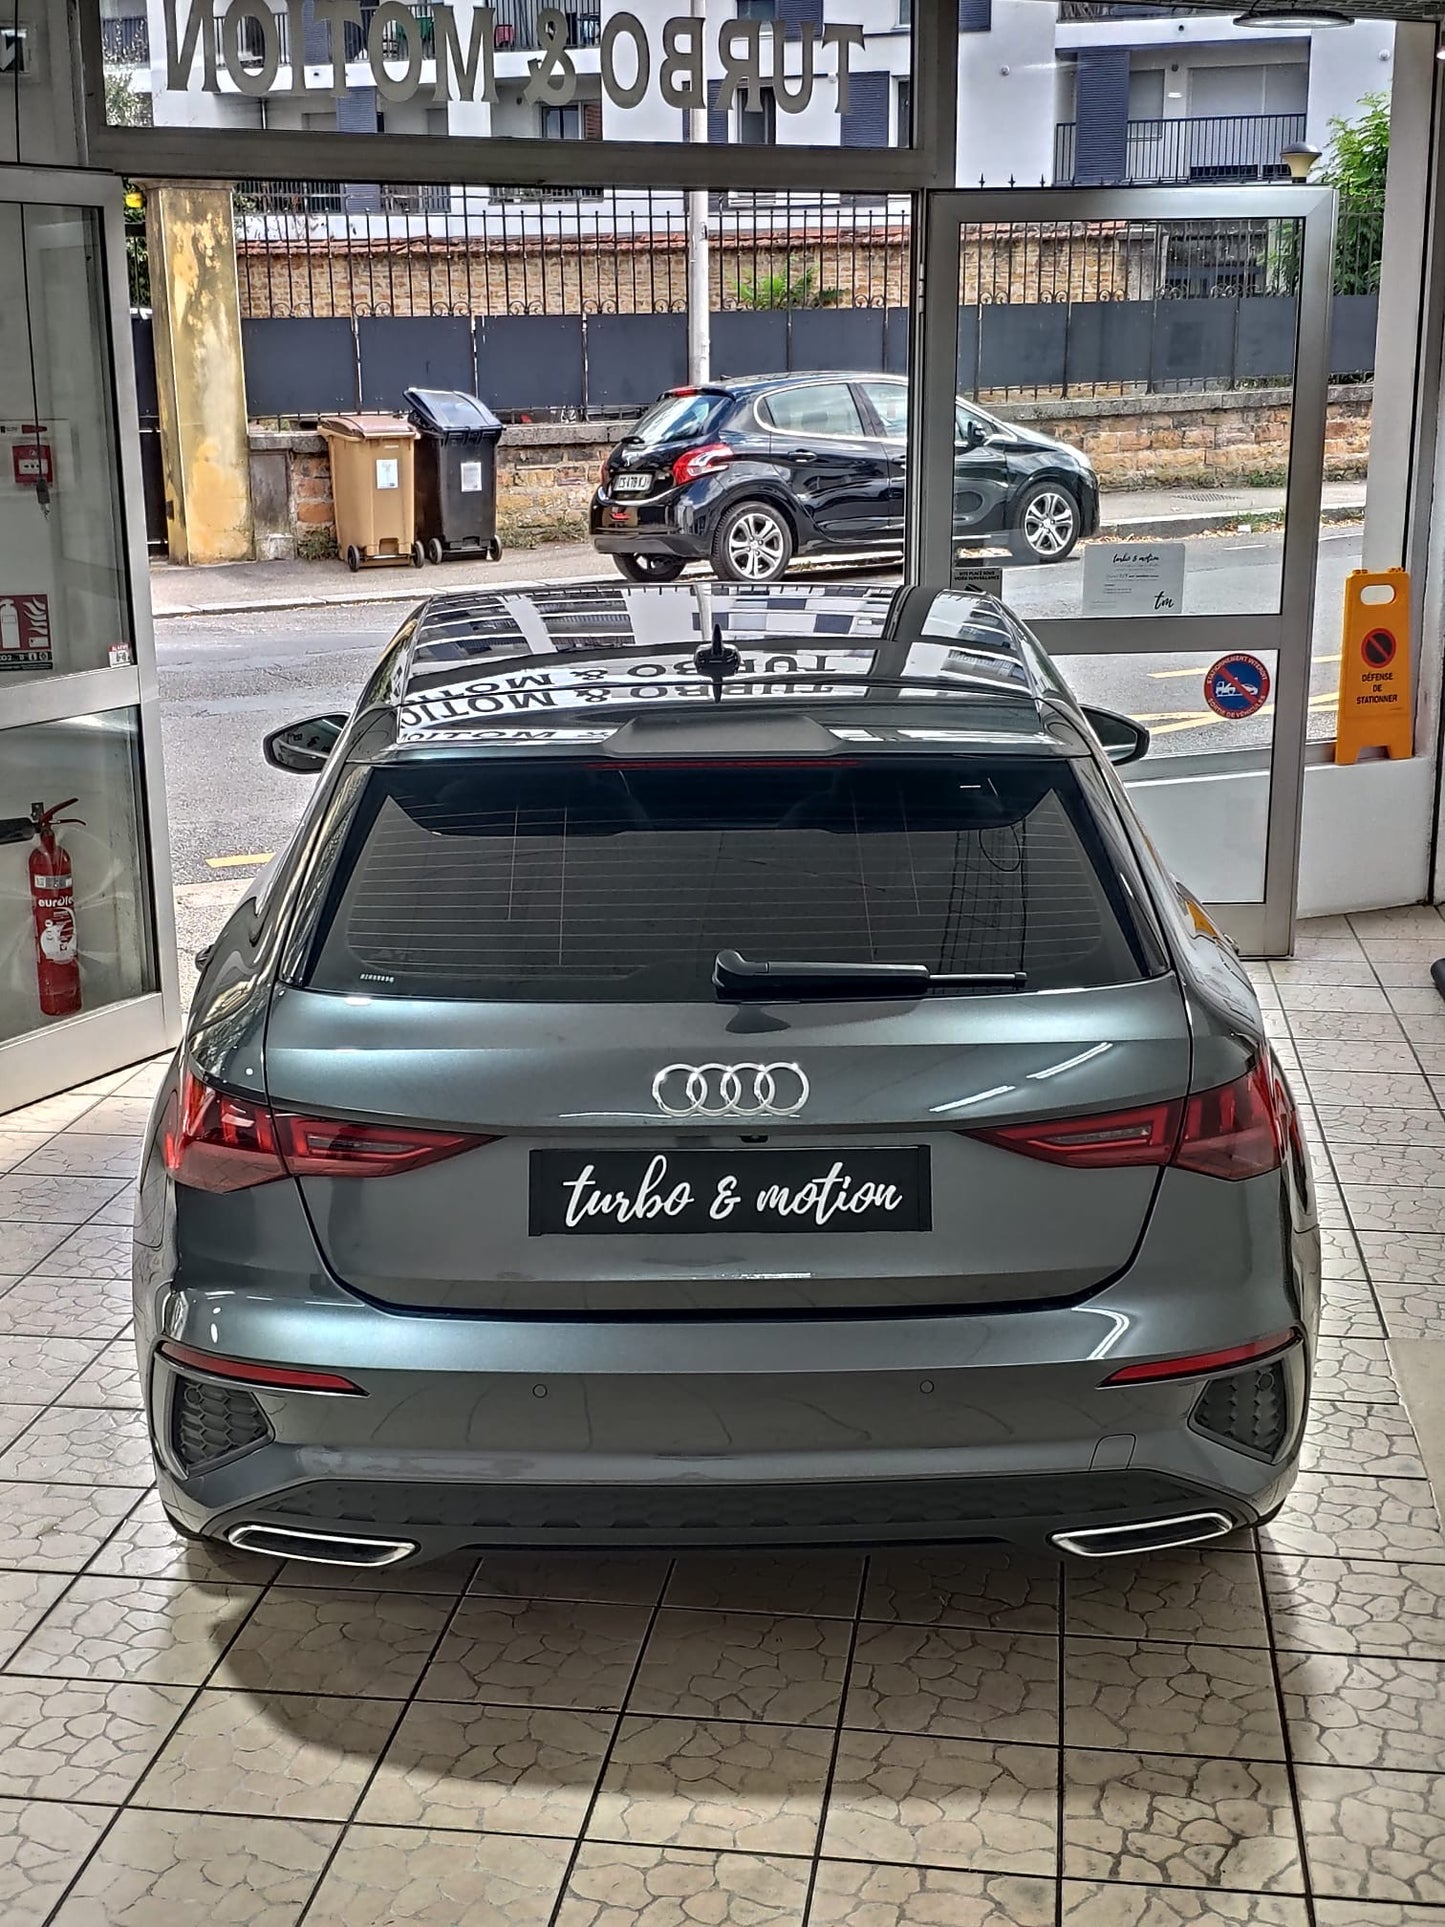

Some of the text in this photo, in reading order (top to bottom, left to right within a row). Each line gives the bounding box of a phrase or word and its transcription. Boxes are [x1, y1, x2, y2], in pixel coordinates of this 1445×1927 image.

[1361, 671, 1394, 682] DÉFENSE
[1372, 684, 1383, 692] DE
[1356, 694, 1398, 705] STATIONNER
[562, 1154, 903, 1228] turbo & motion
